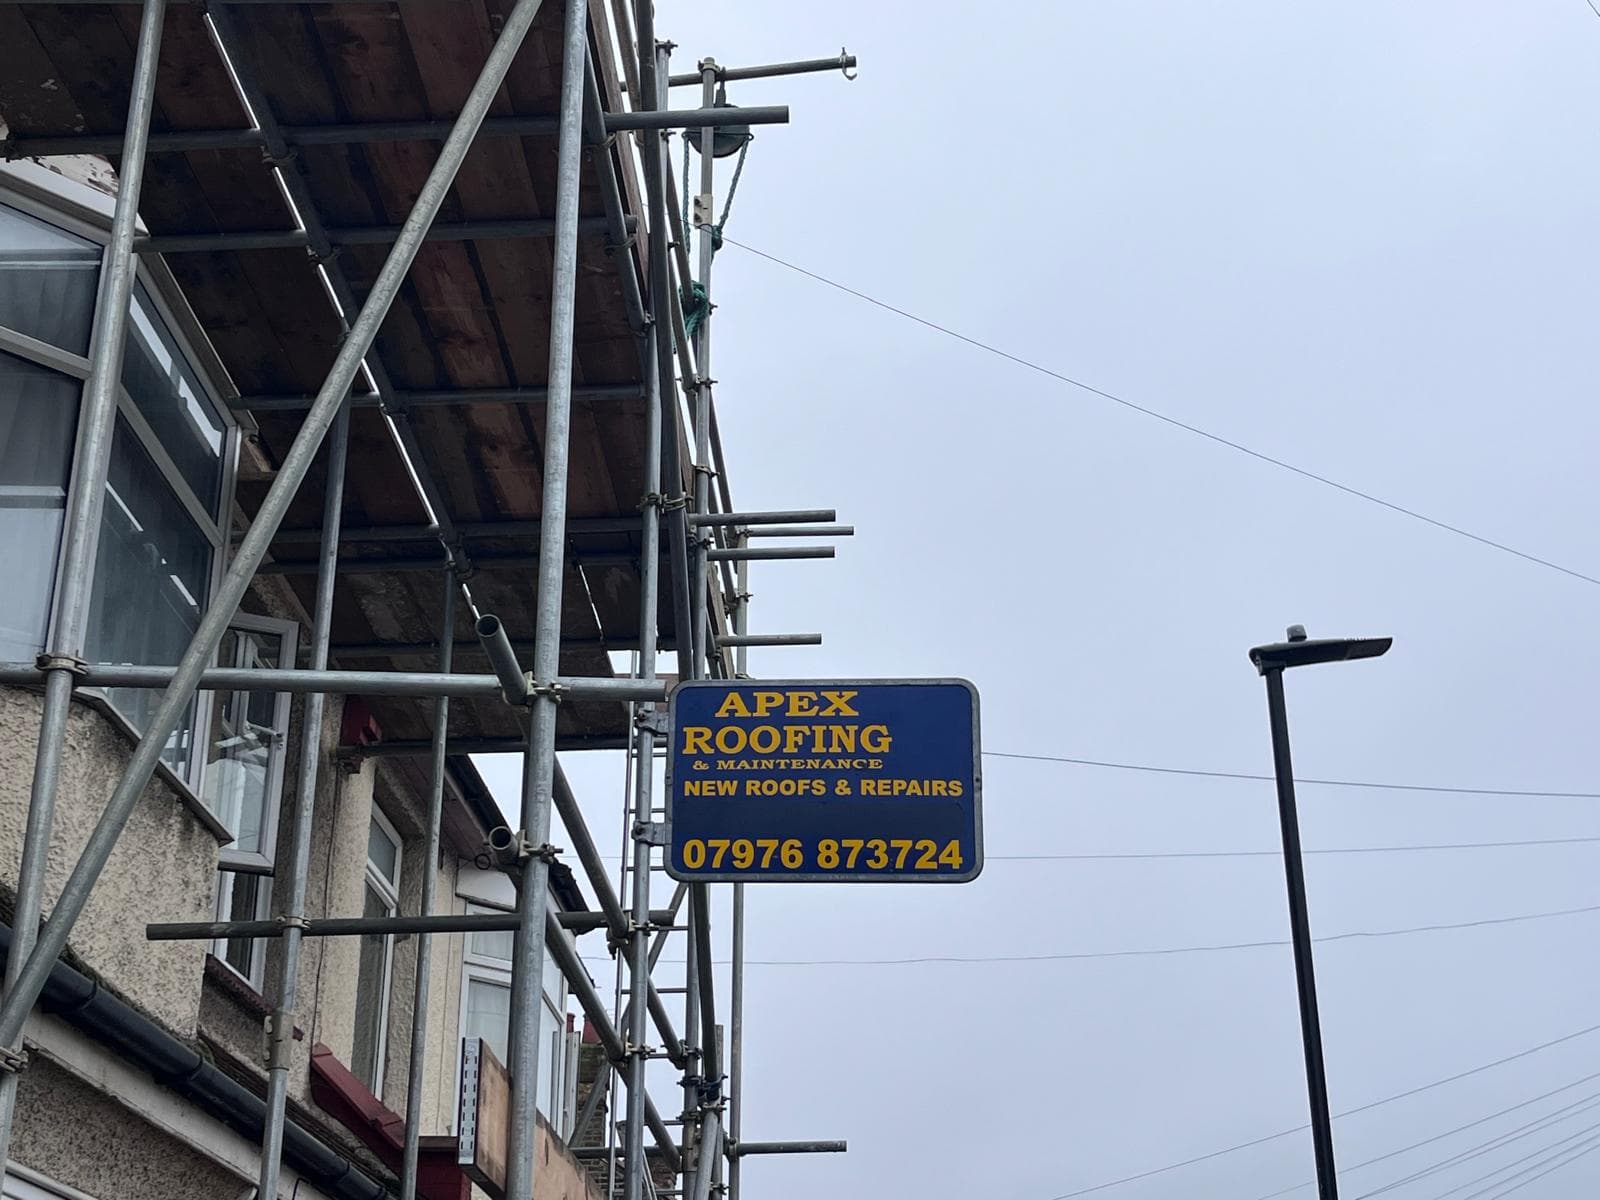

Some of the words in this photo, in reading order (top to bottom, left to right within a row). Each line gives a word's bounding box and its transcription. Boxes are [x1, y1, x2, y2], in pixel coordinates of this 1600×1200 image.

[715, 691, 859, 718] APEX
[682, 725, 893, 755] ROOFING
[692, 759, 709, 770] &
[716, 758, 883, 770] MAINTENANCE
[683, 779, 738, 797] NEW
[745, 779, 827, 797] ROOFS
[834, 778, 852, 797] &
[860, 779, 963, 797] REPAIRS
[682, 839, 804, 869] 07976
[816, 839, 963, 870] 873724
